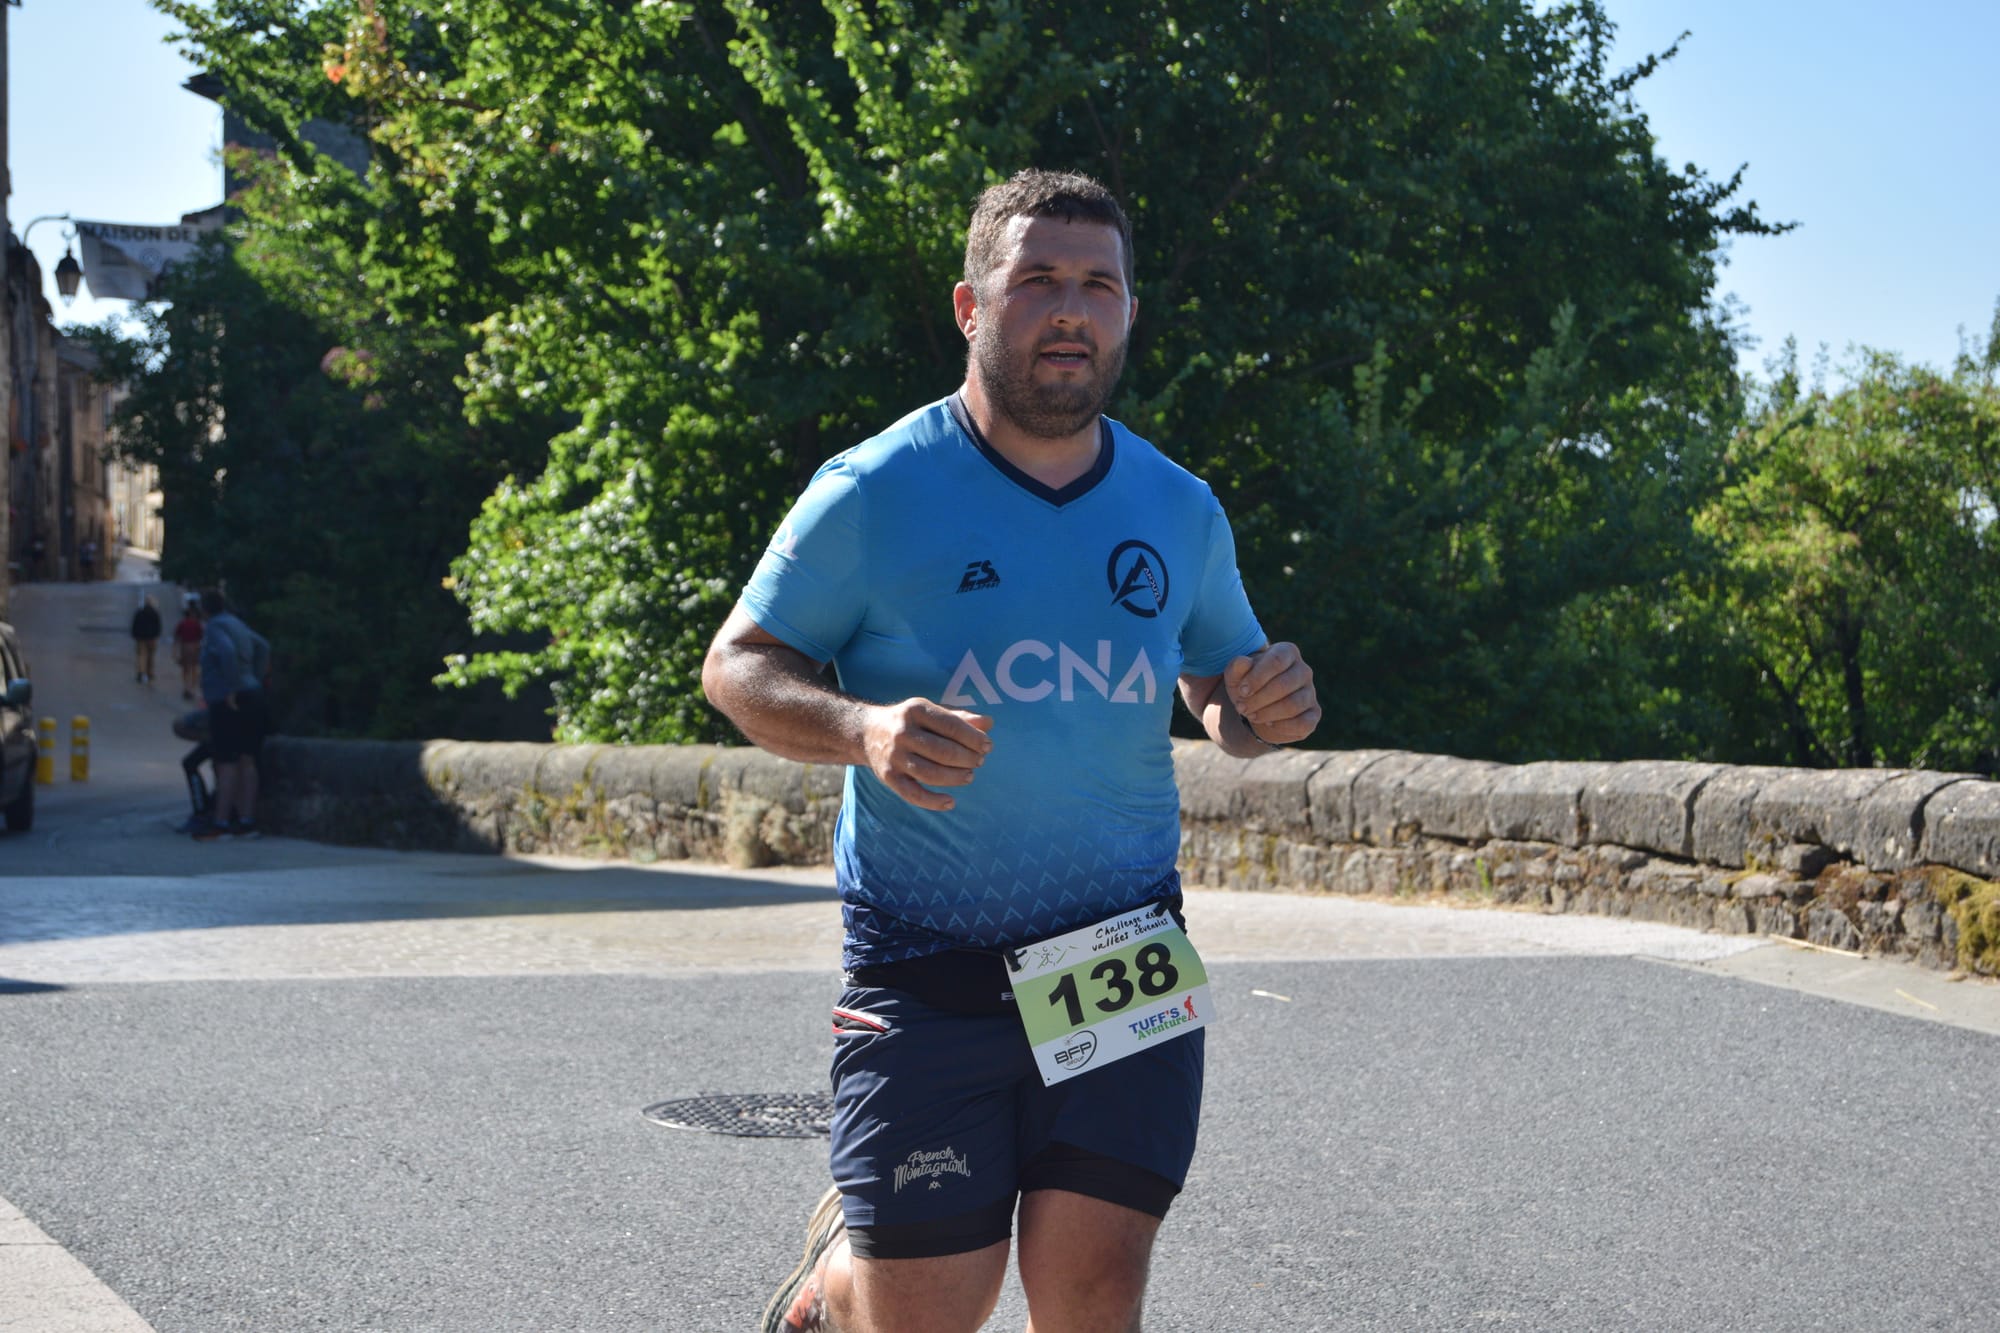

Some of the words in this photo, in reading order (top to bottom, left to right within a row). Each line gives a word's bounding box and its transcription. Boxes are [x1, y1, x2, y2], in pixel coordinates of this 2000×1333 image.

[82, 224, 161, 241] MAISON
[167, 228, 192, 241] DE
[939, 639, 1157, 706] ACNA
[1096, 916, 1142, 939] Challenge
[1048, 942, 1179, 1026] 138
[1129, 1007, 1180, 1034] TUFF'S
[1137, 1015, 1188, 1040] Aventure
[1054, 1041, 1092, 1064] BFP
[907, 1146, 955, 1167] French
[893, 1153, 971, 1193] Montagnard
